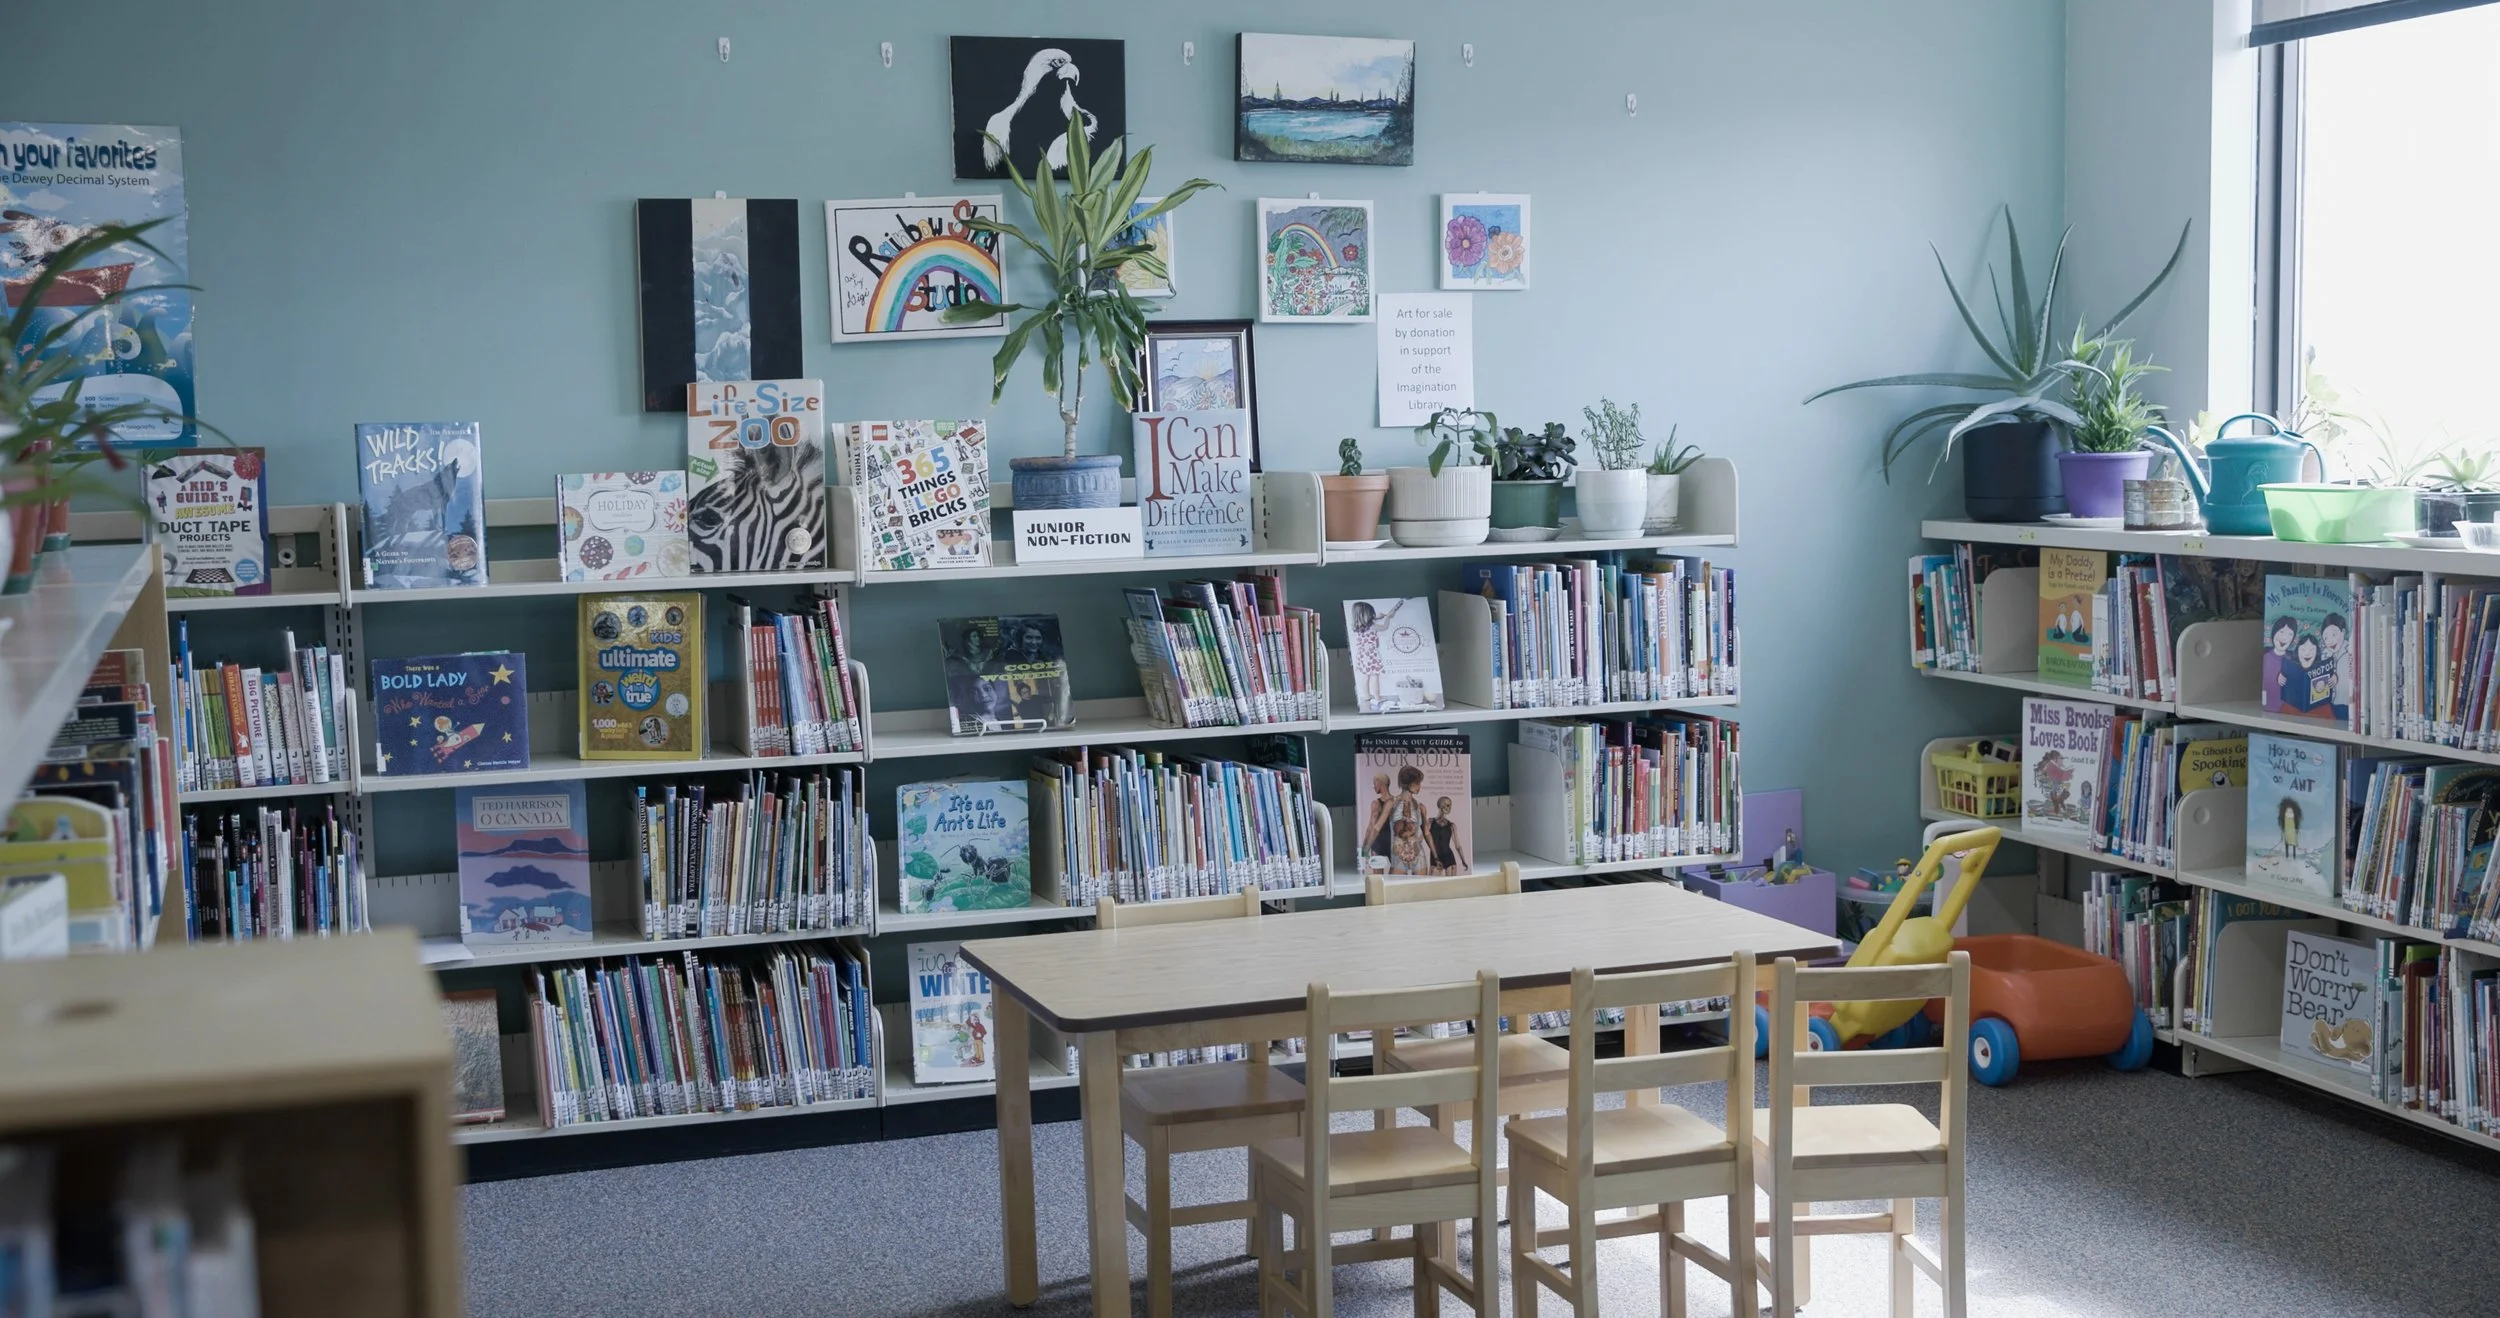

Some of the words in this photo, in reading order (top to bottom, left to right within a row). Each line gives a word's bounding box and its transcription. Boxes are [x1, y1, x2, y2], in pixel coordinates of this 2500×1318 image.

[13, 143, 60, 171] your
[66, 137, 157, 170] favorites
[12, 173, 53, 186] Dewey
[57, 173, 104, 186] Decimal
[107, 174, 150, 188] System
[848, 213, 943, 279] Rainbow
[904, 271, 980, 312] Studio
[1397, 309, 1412, 318] Art
[1415, 308, 1430, 318] for
[1433, 308, 1453, 318] sale
[1395, 328, 1407, 339] by
[1410, 328, 1455, 338] donation
[1400, 346, 1409, 355] in
[1412, 346, 1451, 357] support
[1411, 364, 1422, 374] of
[1425, 364, 1441, 374] the
[1397, 383, 1457, 394] Imagination
[688, 382, 819, 417] Life-Size
[1408, 400, 1443, 410] Library
[708, 416, 800, 449] ZOO
[1167, 416, 1240, 462] Can
[366, 427, 419, 457] WILD
[365, 440, 444, 484] TRACKS!
[896, 447, 951, 485] 365
[898, 470, 957, 499] THINGS
[1169, 459, 1243, 495] Make
[190, 481, 228, 491] KID'S
[176, 492, 219, 503] GUIDE
[598, 500, 648, 511] HOLIDAY
[914, 483, 961, 511] LEGO
[1200, 494, 1216, 508] A
[175, 504, 236, 519] AWESOME
[908, 497, 967, 528] BRICKS
[1146, 500, 1244, 527] Difference
[158, 521, 203, 534] DUCT
[208, 520, 251, 533] TAPE
[1027, 522, 1085, 534] JUNIOR
[180, 533, 231, 542] PROJECTS
[1027, 533, 1131, 547] NON-FICTION
[2066, 555, 2095, 570] Daddy
[2065, 568, 2095, 582] Pretzel
[2280, 582, 2311, 598] Family
[1658, 588, 1668, 639] Science
[650, 632, 682, 644] KIDS
[602, 648, 676, 668] ultimate
[2307, 660, 2337, 679] PHOTOS!
[381, 675, 422, 690] BOLD
[428, 672, 467, 688] LADY
[620, 669, 657, 688] weird
[248, 680, 257, 696] BIG
[626, 690, 652, 703] true
[251, 699, 262, 738] PICTURE
[2030, 703, 2060, 726] Miss
[2029, 726, 2065, 749] Loves
[2068, 730, 2098, 752] Book
[1361, 747, 1410, 768] YOUR
[1415, 747, 1463, 768] BODY
[2202, 746, 2233, 756] Ghosts
[2294, 748, 2306, 760] to
[2192, 756, 2246, 773] Spooking
[2289, 778, 2316, 793] ANT
[480, 801, 503, 811] TED
[506, 800, 563, 810] HARRISON
[949, 794, 973, 813] It's
[976, 798, 995, 811] an
[496, 812, 563, 825] CANADA
[934, 812, 974, 832] Ant's
[977, 811, 1007, 830] Life
[689, 837, 698, 893] ENCYCLOPEDIA
[2236, 903, 2257, 916] GOT
[2259, 902, 2279, 915] YOU
[2290, 940, 2350, 977] Don't
[2289, 965, 2364, 1010] Worry
[2286, 990, 2344, 1026] Bear
